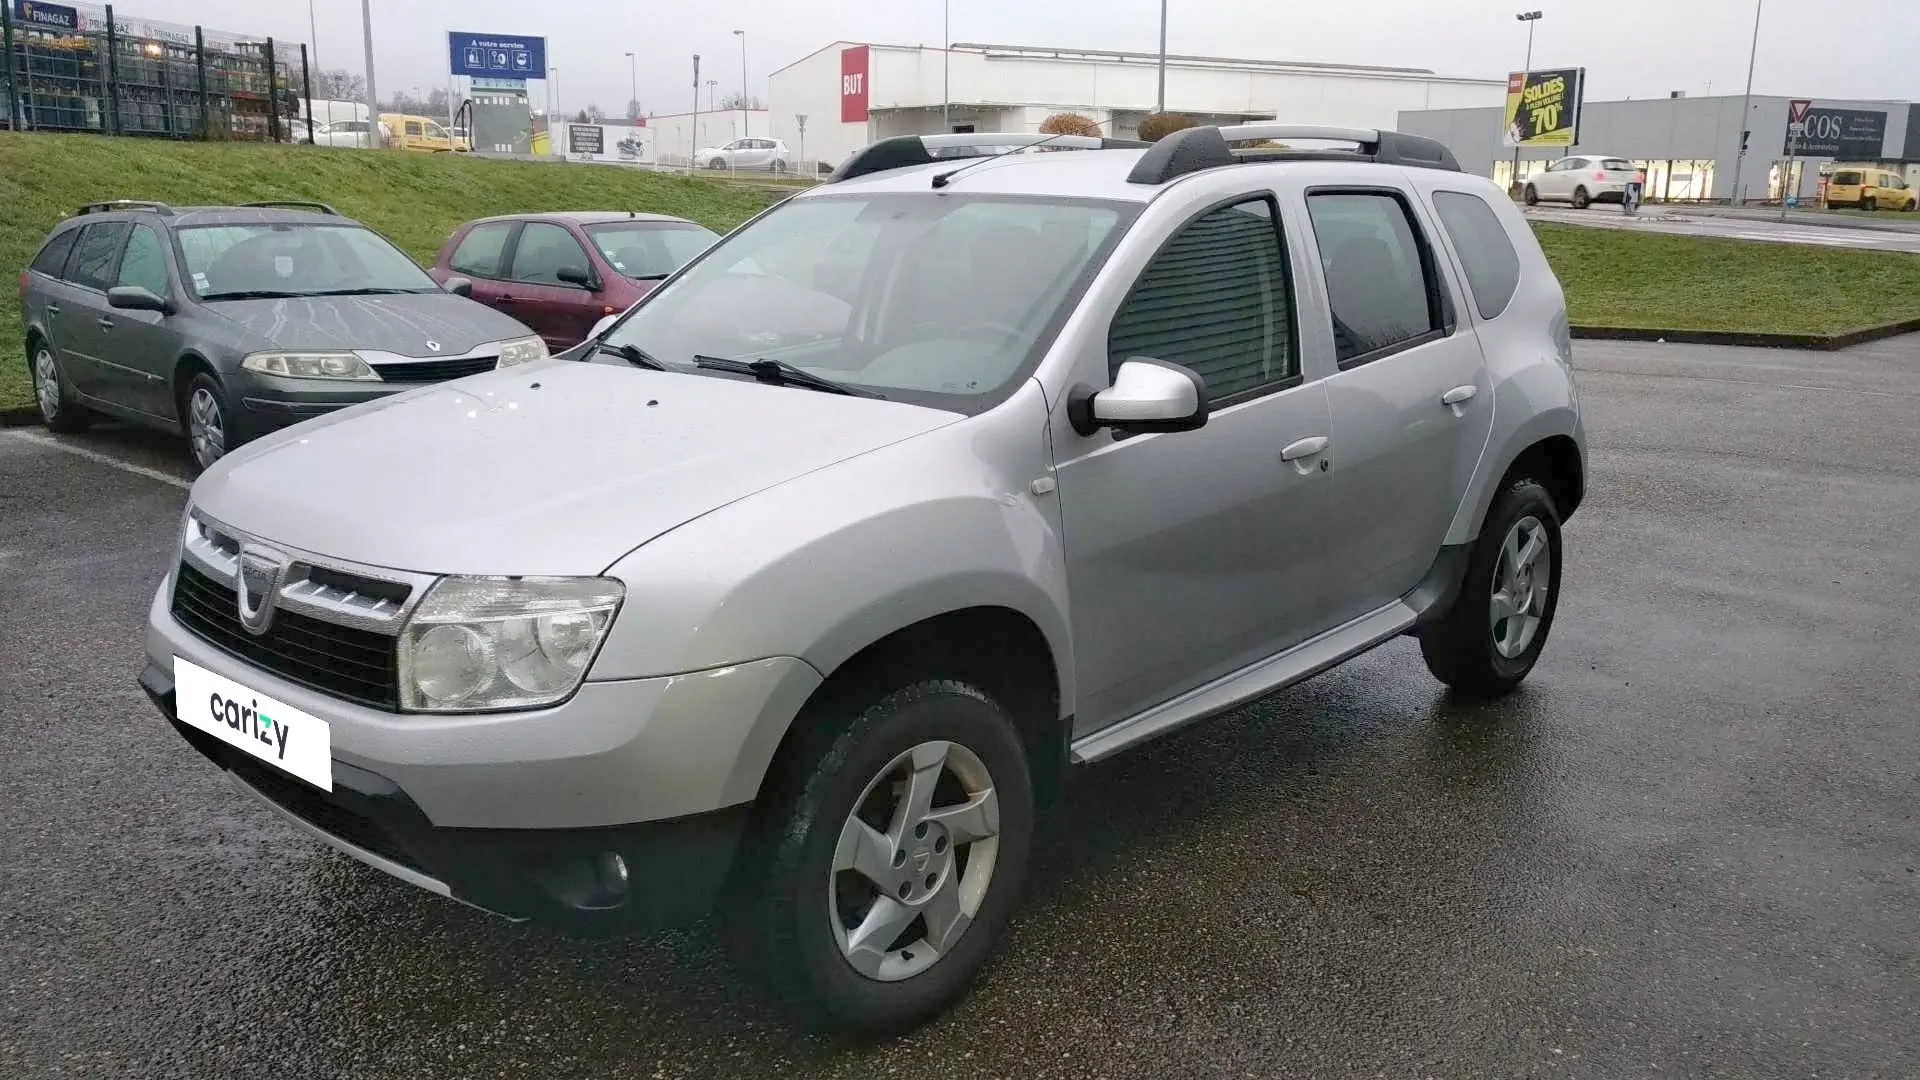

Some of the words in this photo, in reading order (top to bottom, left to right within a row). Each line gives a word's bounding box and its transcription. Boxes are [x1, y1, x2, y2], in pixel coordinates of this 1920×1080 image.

[33, 10, 71, 25] FINAGAZ
[89, 18, 129, 34] PRIMGAZ
[843, 73, 863, 95] BUT
[1524, 76, 1564, 104] SOLDES
